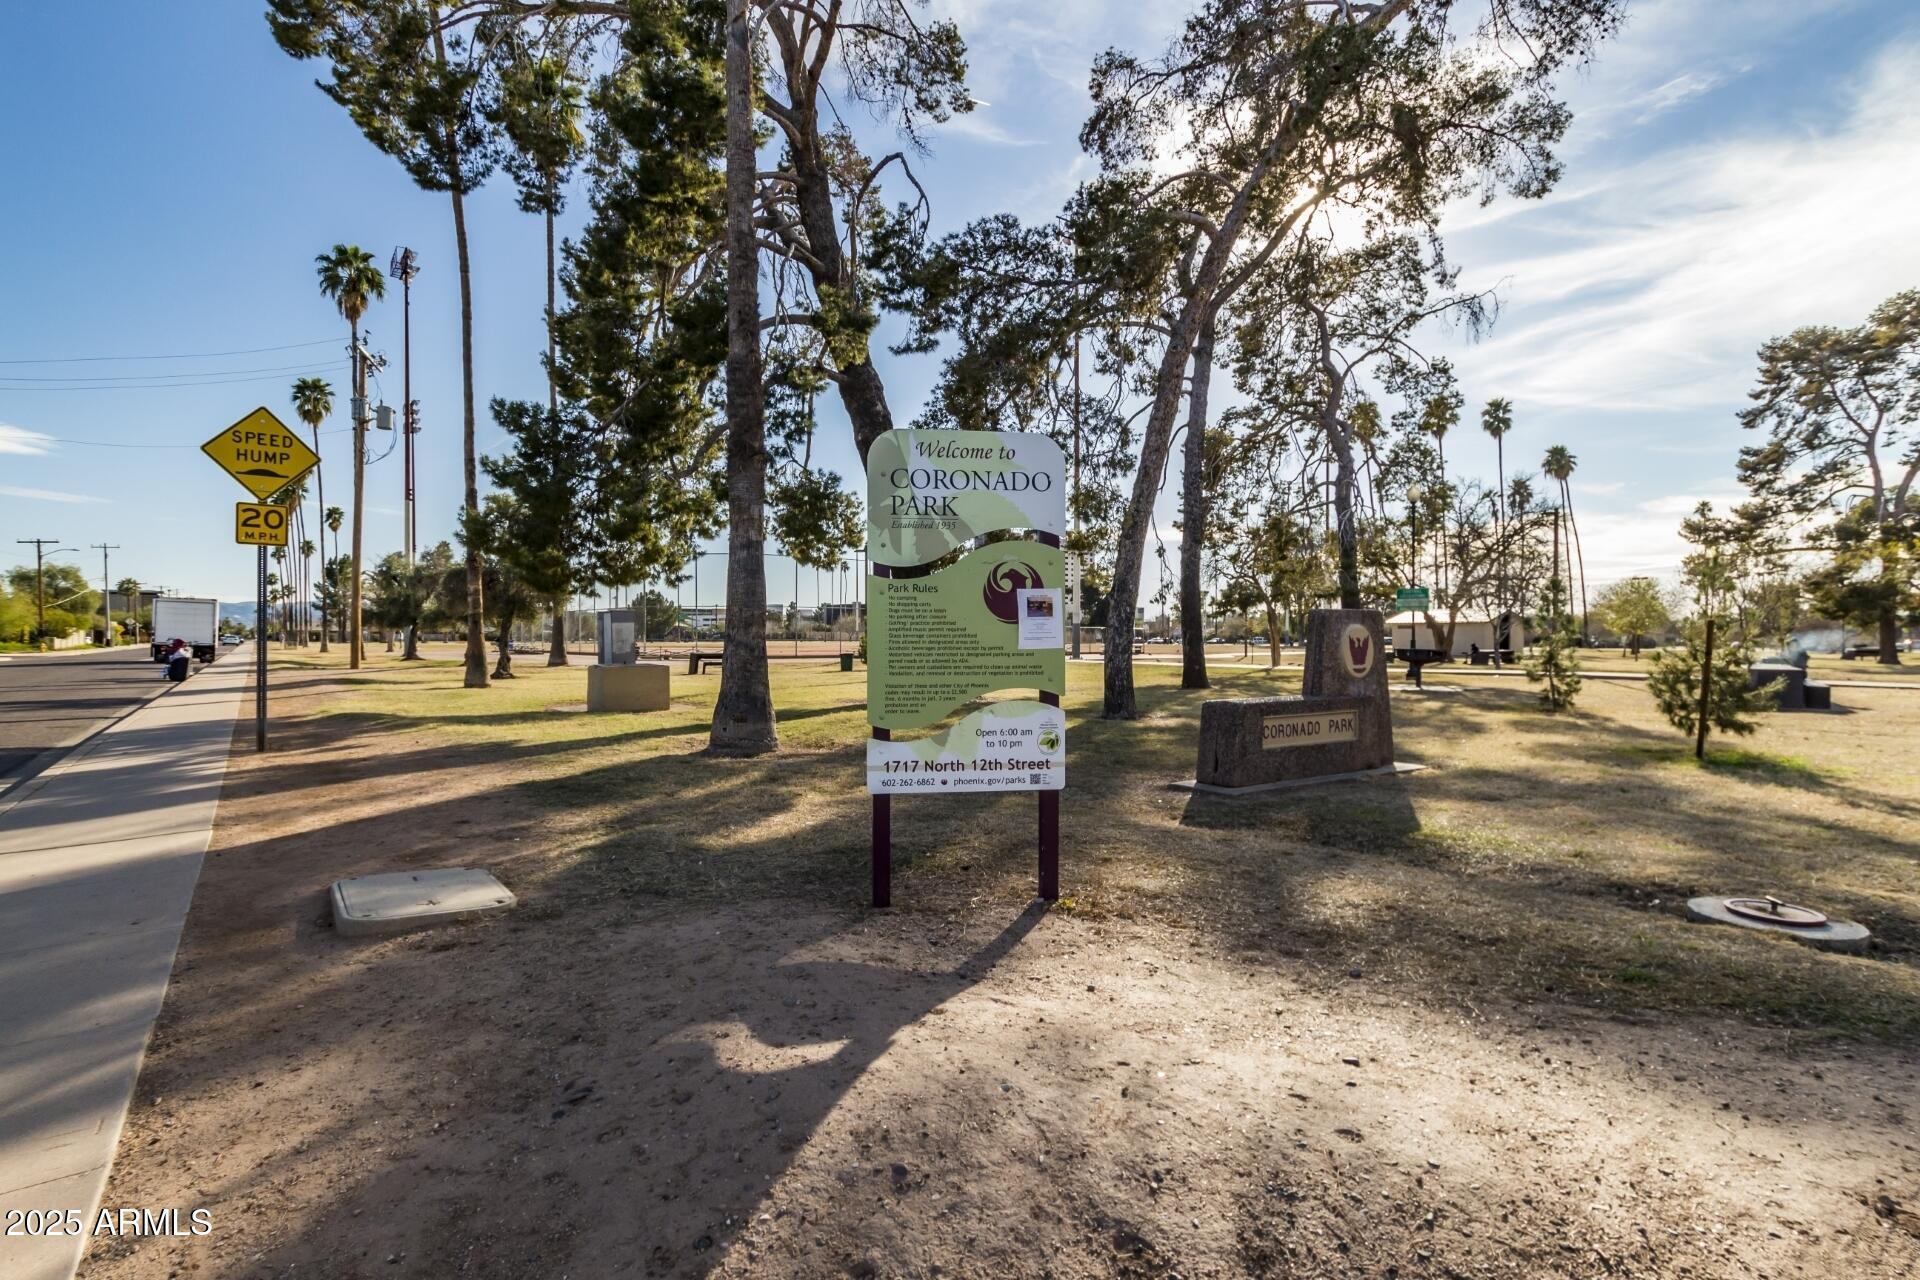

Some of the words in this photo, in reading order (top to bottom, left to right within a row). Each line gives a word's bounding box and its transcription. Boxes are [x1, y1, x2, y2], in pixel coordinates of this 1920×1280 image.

[232, 430, 293, 449] SPEED
[236, 448, 290, 465] HUMP
[916, 440, 993, 460] Welcome
[1000, 447, 1015, 460] to
[890, 468, 1052, 492] CORONADO
[890, 495, 959, 516] PARK
[241, 507, 284, 529] 20
[891, 520, 933, 530] Established
[887, 584, 909, 592] Park
[912, 584, 938, 593] Rules
[975, 728, 997, 738] Open
[1000, 728, 1018, 736] 6:00
[1263, 721, 1321, 739] CORONADO
[1329, 718, 1354, 734] PARK
[986, 740, 995, 748] to
[998, 739, 1007, 748] 10
[1009, 741, 1023, 750] pm
[883, 760, 920, 773] 1717
[924, 760, 965, 772] North
[971, 759, 1003, 771] 12th
[1007, 758, 1051, 770] Street
[881, 777, 936, 787] 602-262-6862
[953, 776, 1026, 786] phoenix.gov/parks
